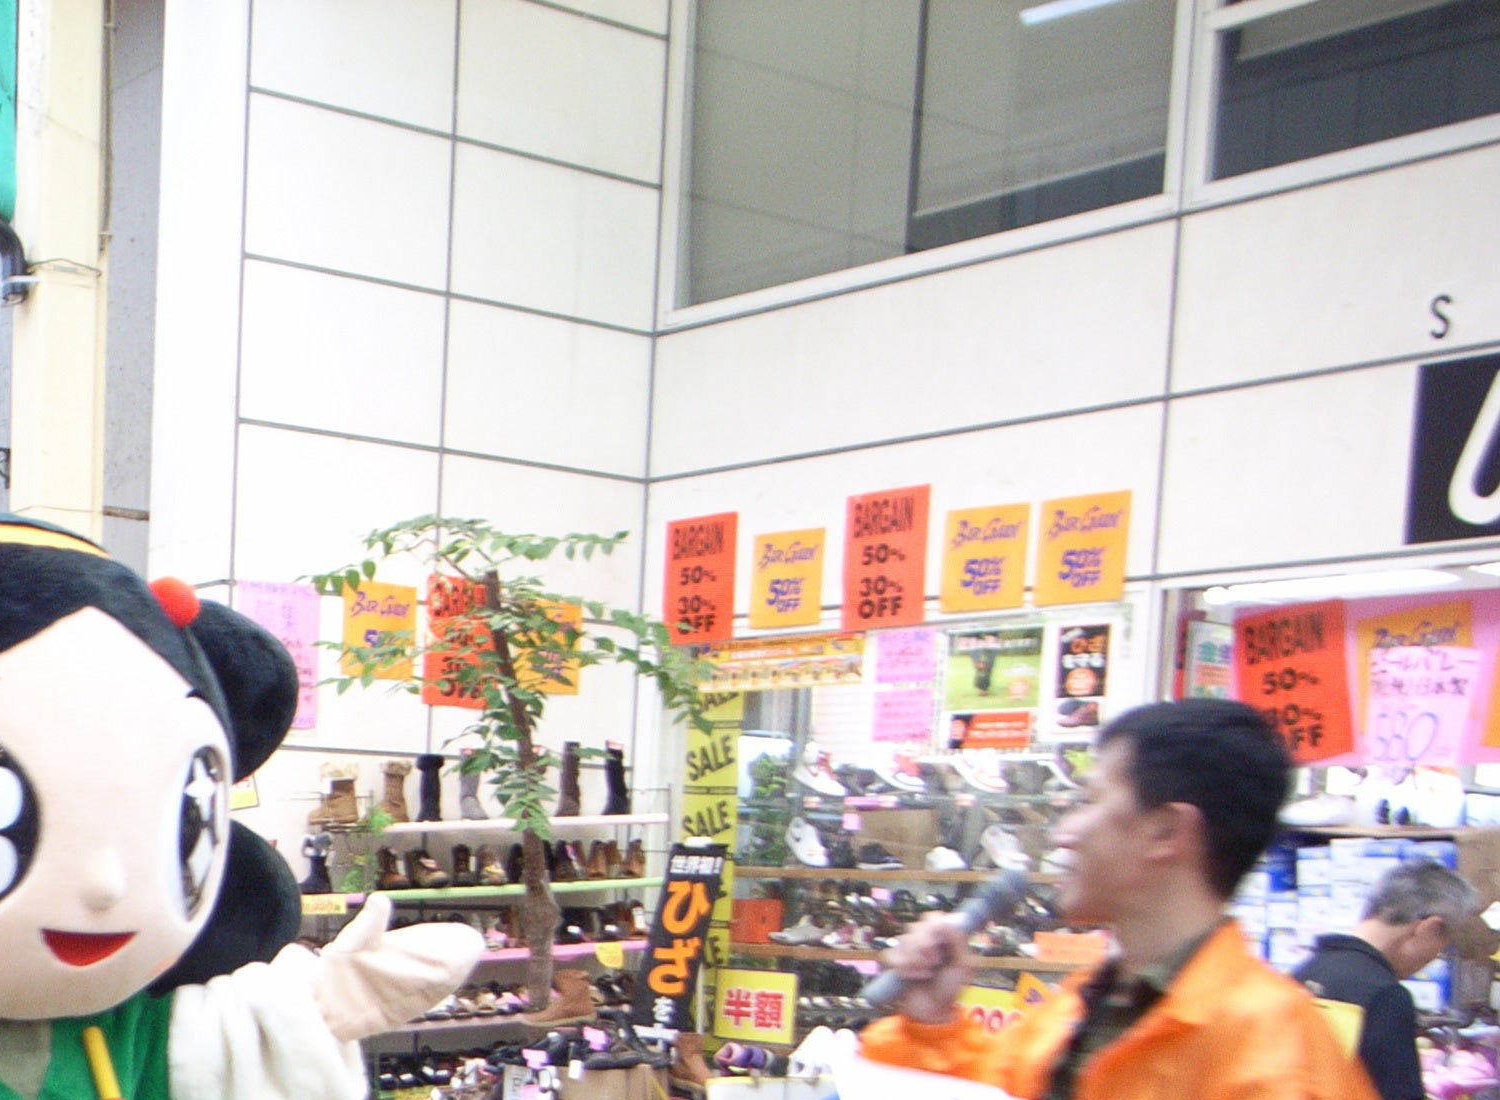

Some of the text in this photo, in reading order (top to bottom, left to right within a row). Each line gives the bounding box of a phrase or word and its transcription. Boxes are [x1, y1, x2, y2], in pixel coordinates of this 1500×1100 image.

[857, 595, 903, 619] OFF
[686, 734, 737, 783] SALE
[682, 800, 733, 838] SALE
[722, 987, 786, 1031] 半額
